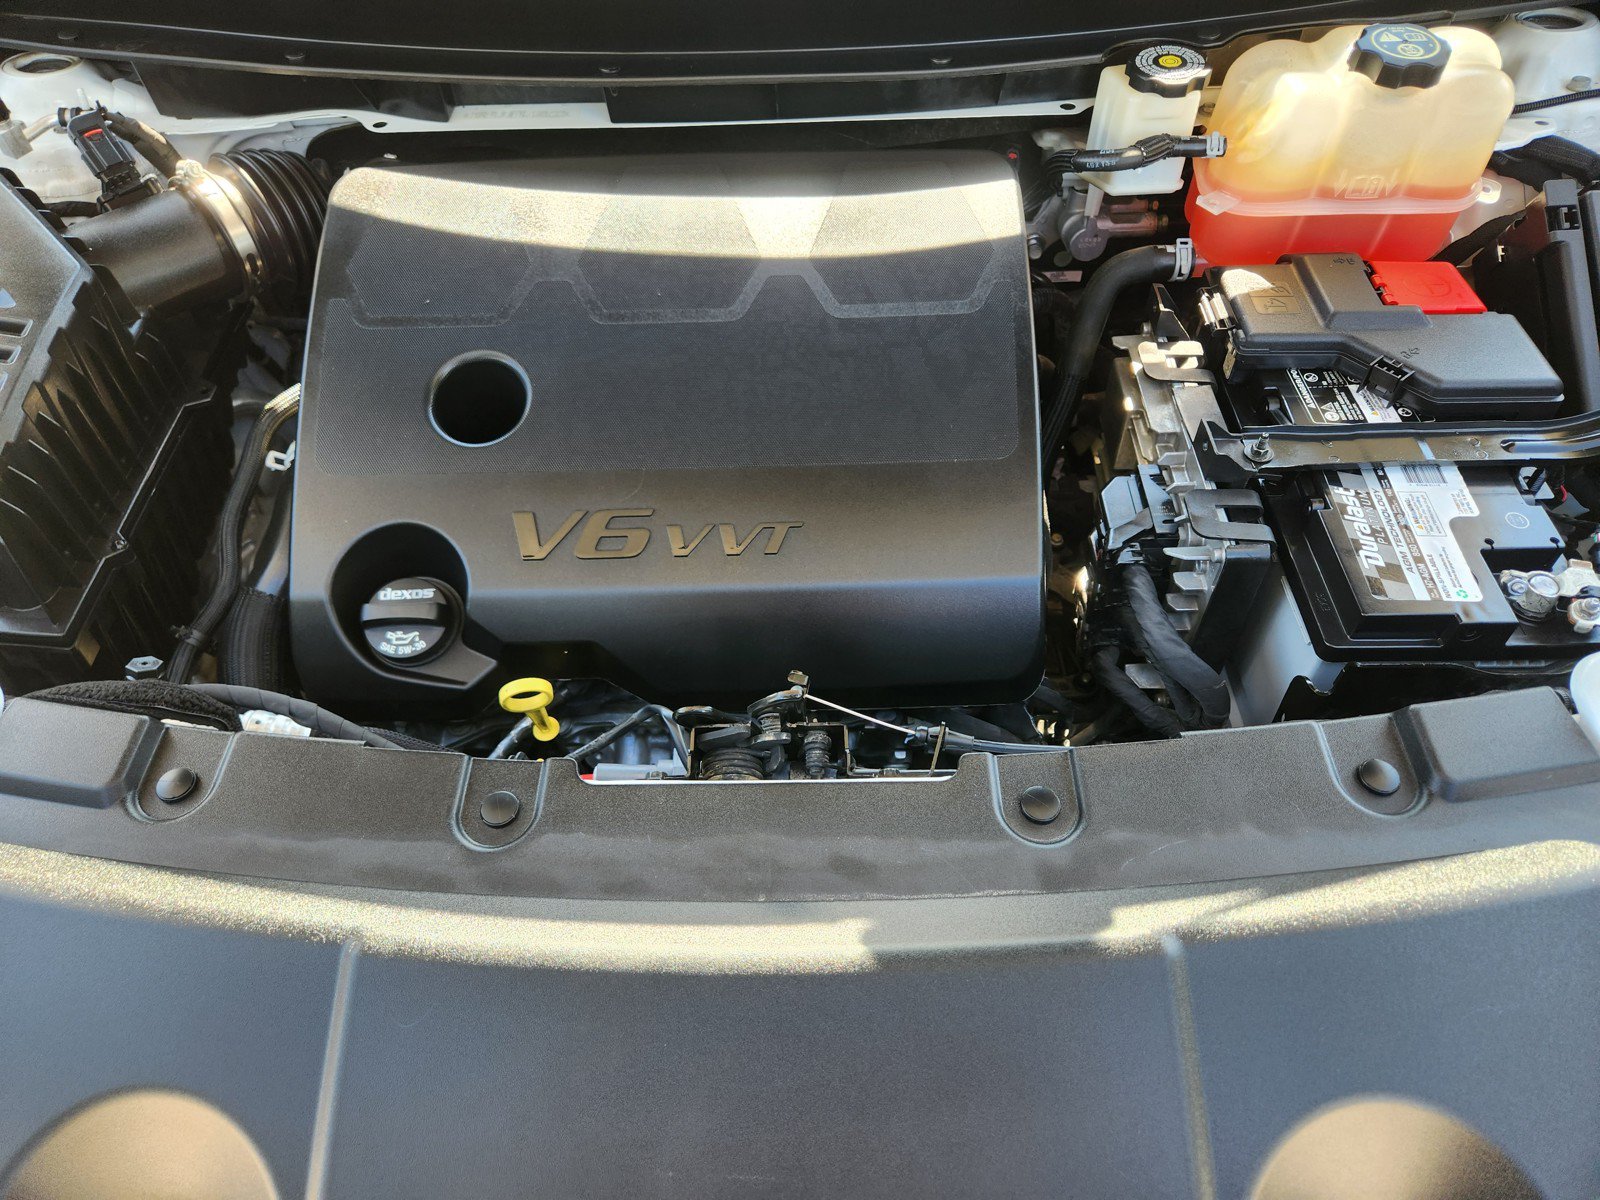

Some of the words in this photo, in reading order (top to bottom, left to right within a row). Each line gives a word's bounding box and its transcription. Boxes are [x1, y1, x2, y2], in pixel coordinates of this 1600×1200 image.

[512, 508, 655, 561] V6
[666, 521, 804, 557] VVT
[1334, 486, 1386, 570] Duralast
[1356, 489, 1389, 545] PLATINUM
[1371, 487, 1406, 548] TECHNOLOGY
[1399, 550, 1415, 574] AGM
[1409, 544, 1421, 557] 850
[1416, 563, 1434, 588] H7-AGM
[1426, 553, 1453, 599] NON-SPILLABLE
[378, 587, 436, 601] dexos
[380, 641, 397, 654] SAE
[397, 640, 427, 655] 5W-30
